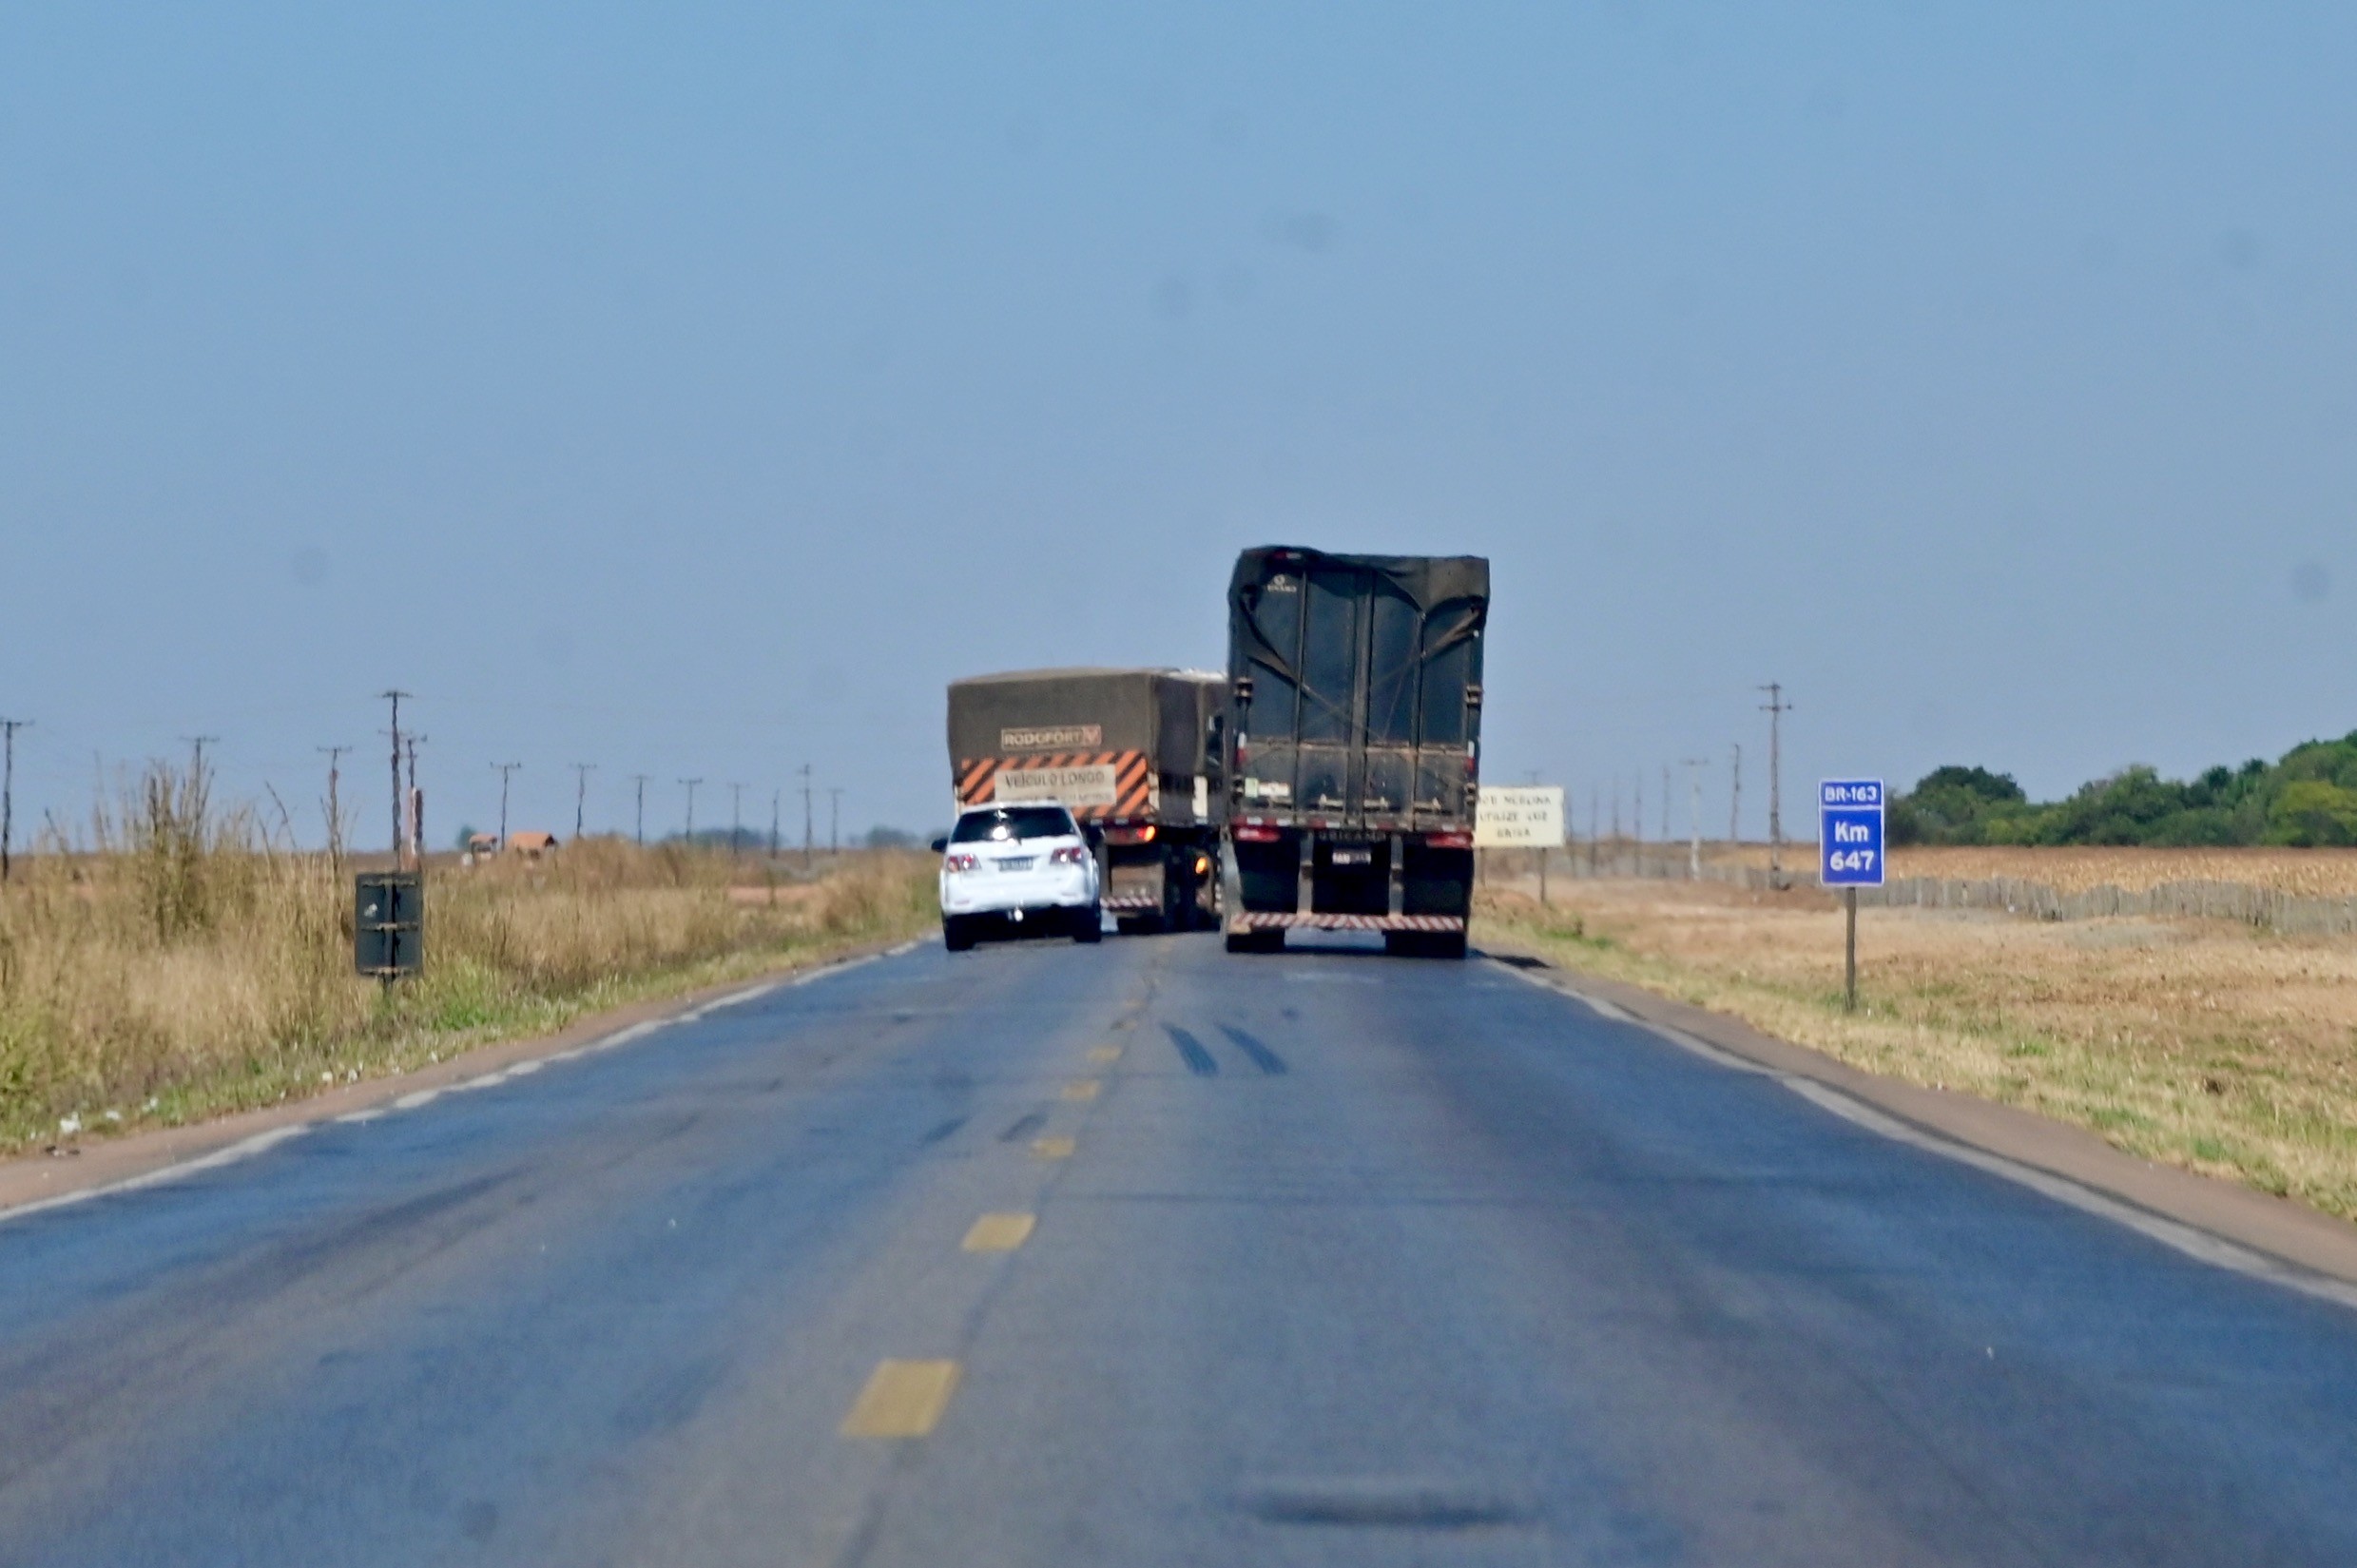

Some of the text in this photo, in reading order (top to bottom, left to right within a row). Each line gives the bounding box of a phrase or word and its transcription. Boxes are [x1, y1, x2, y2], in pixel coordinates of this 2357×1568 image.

[1004, 731, 1080, 745] RODOFORT
[1061, 770, 1105, 786] LONGO
[1825, 785, 1877, 802] BR-163
[1834, 821, 1868, 842] Km
[1830, 850, 1874, 871] 647
